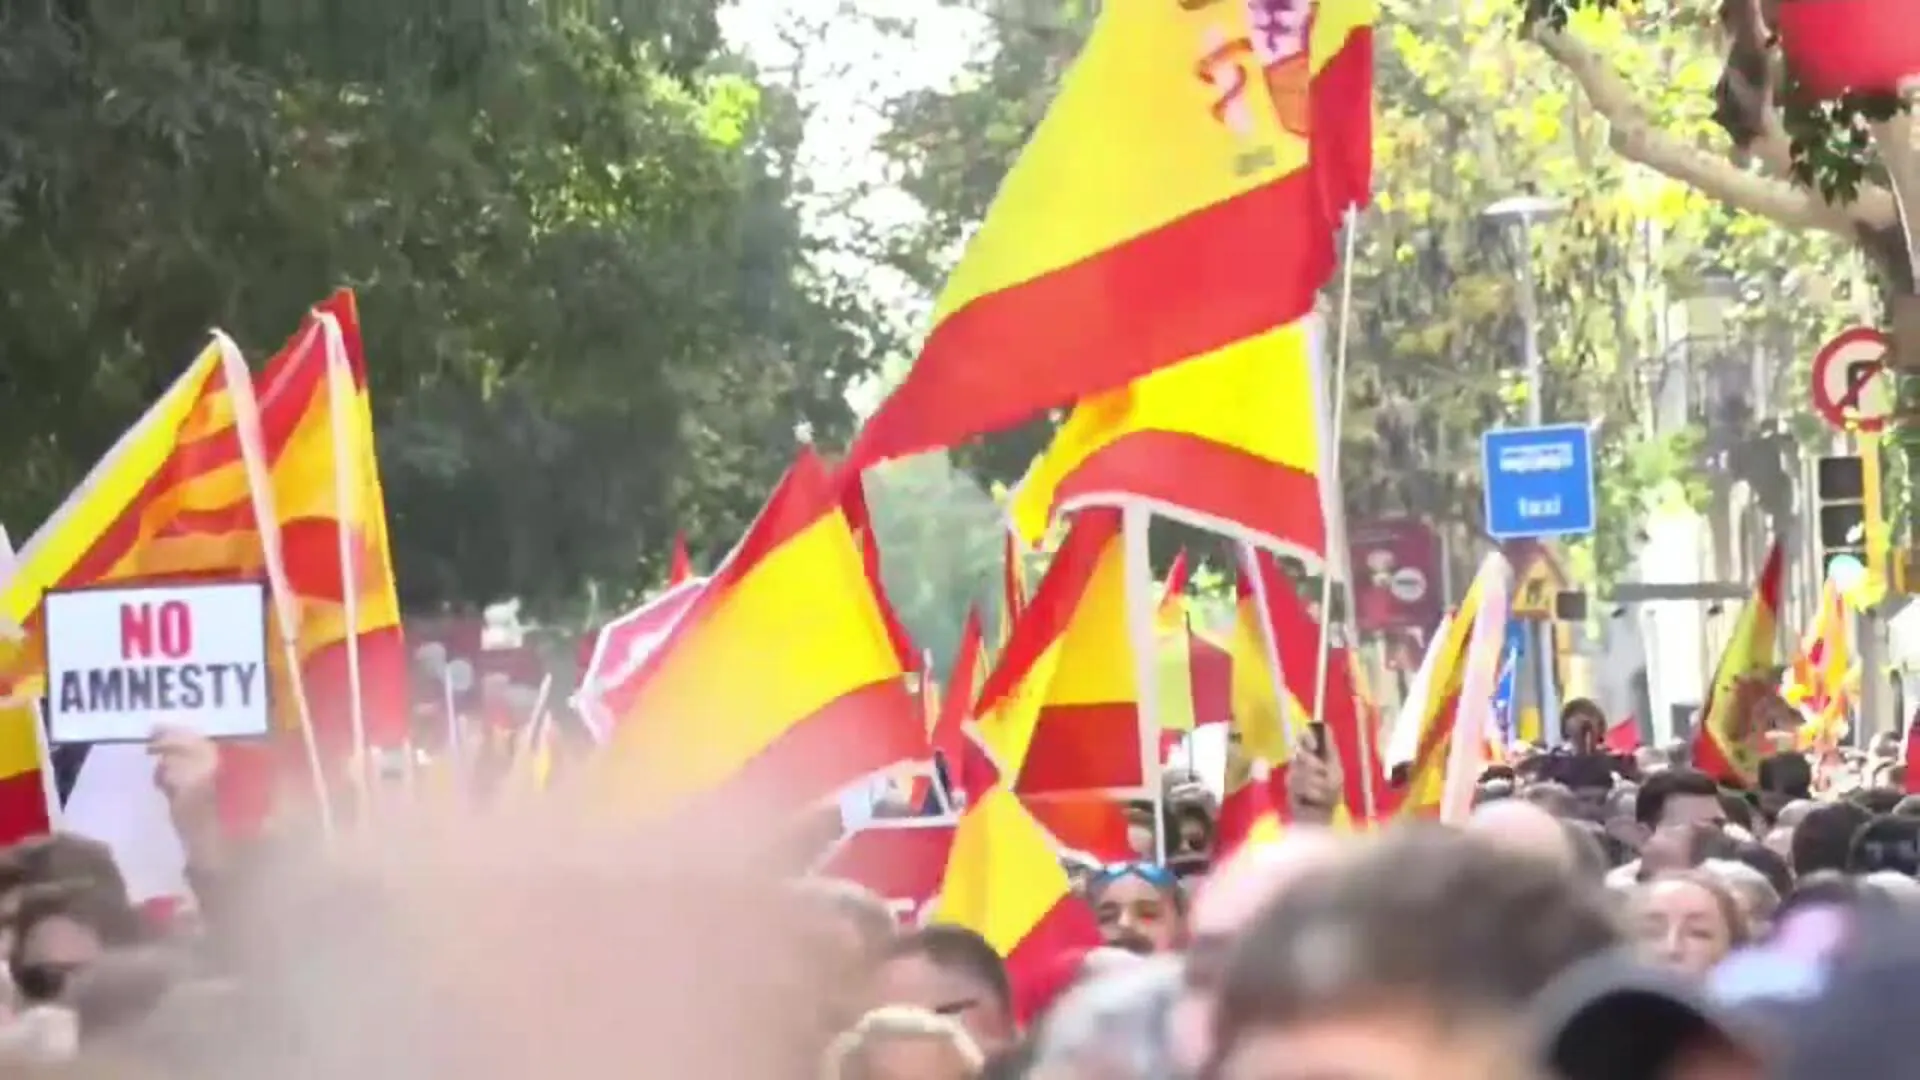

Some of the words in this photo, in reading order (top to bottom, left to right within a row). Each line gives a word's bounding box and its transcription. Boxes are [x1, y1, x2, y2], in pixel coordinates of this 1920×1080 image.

[1518, 495, 1561, 517] taxi
[120, 600, 192, 660] NO
[60, 662, 257, 713] AMNESTY
